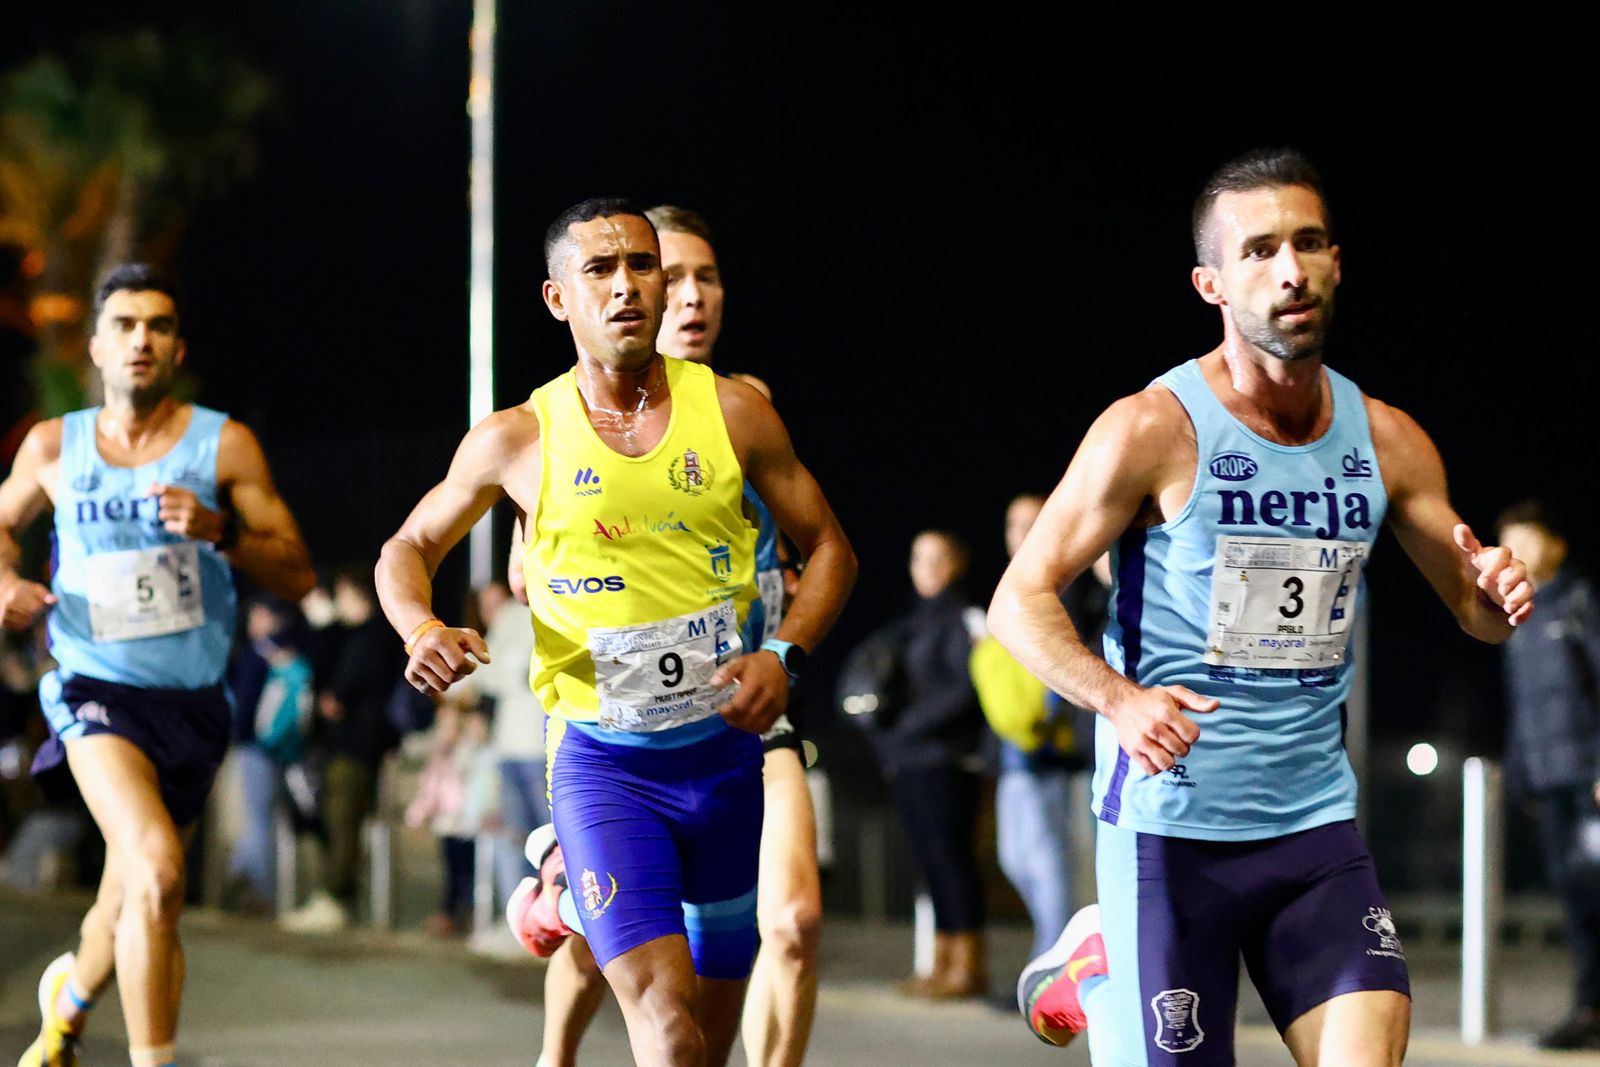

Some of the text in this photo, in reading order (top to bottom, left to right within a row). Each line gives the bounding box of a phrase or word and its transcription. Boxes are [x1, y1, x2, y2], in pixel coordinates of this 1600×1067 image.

[1210, 455, 1257, 478] TROPS
[77, 494, 165, 528] nerj
[1217, 477, 1372, 540] nerja
[137, 576, 154, 603] 5
[548, 576, 626, 594] EVOS
[1279, 576, 1304, 619] 3
[1259, 637, 1306, 650] mayoral
[658, 652, 684, 688] 9
[646, 699, 694, 718] mayoral
